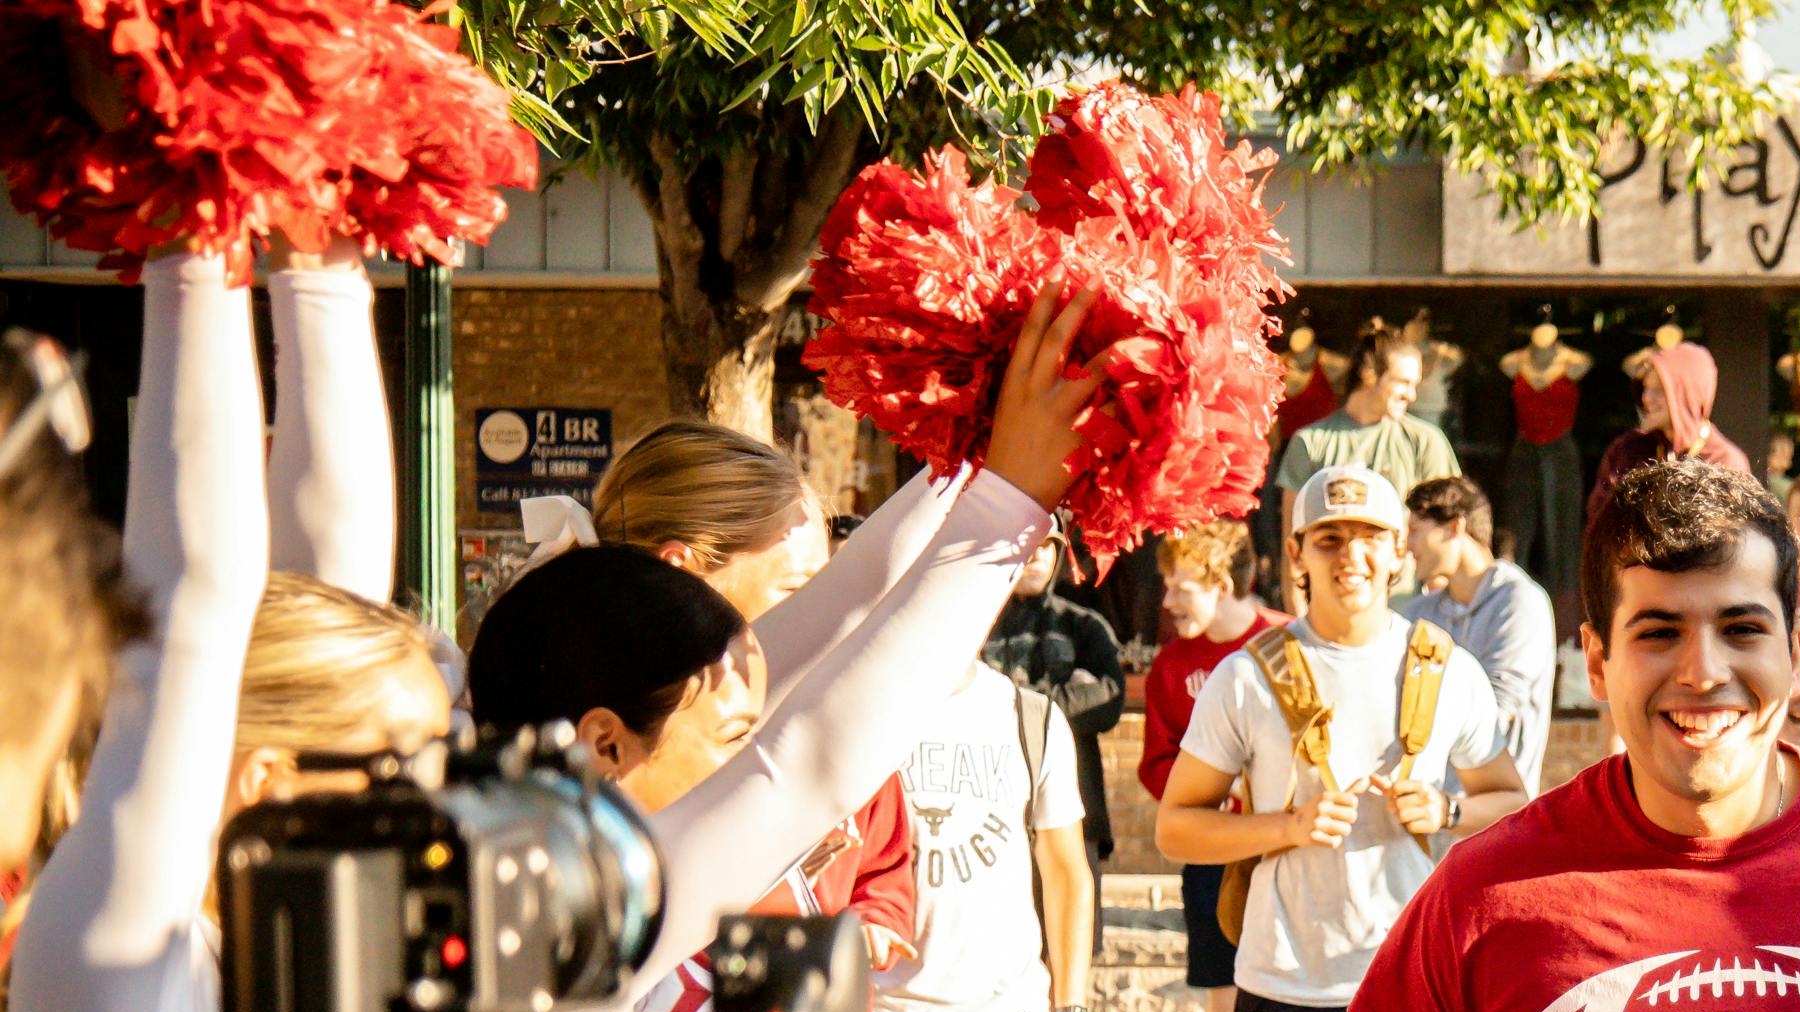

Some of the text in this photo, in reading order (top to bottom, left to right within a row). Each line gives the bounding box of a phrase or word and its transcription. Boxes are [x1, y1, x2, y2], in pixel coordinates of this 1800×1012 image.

[538, 413, 554, 441] 4
[564, 417, 600, 442] BR
[530, 443, 608, 459] Apartment
